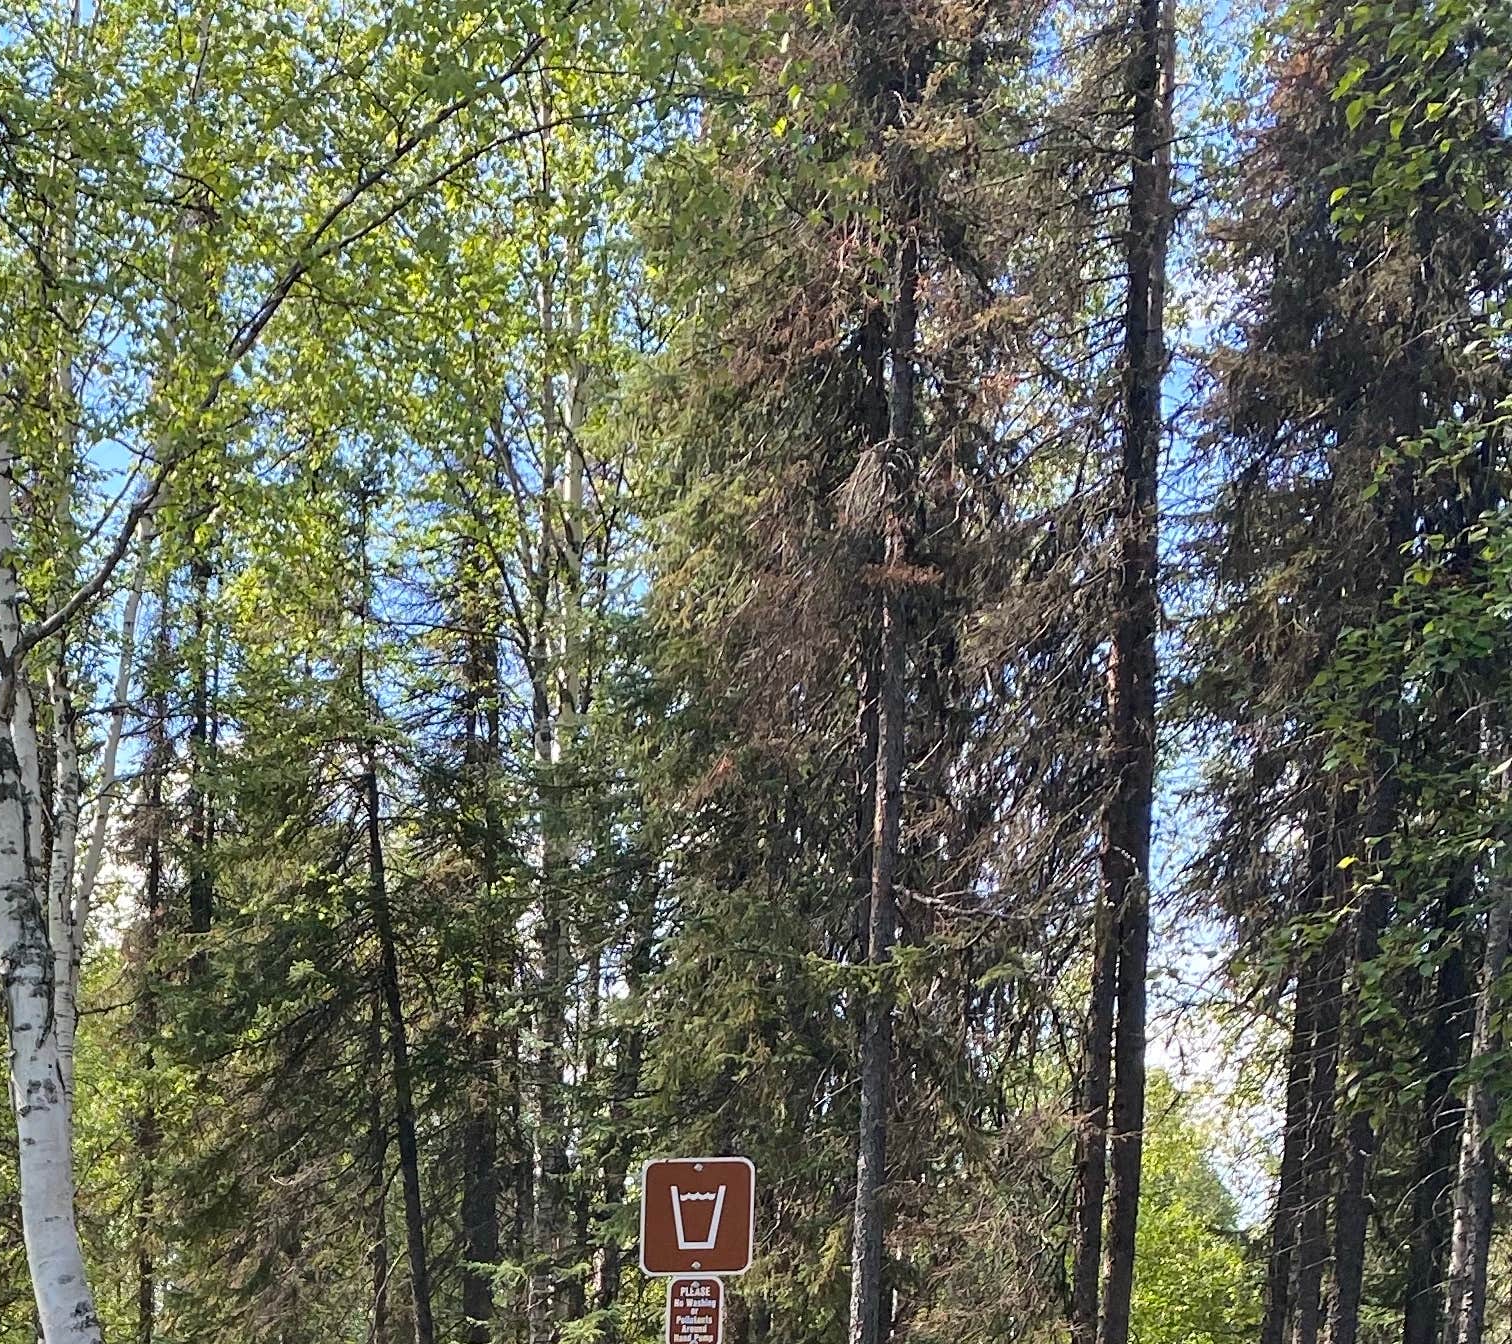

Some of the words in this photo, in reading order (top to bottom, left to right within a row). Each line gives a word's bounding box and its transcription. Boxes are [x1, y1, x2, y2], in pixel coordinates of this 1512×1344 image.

[680, 1286, 711, 1297] PLEASE
[673, 1298, 685, 1308] No
[686, 1298, 717, 1309] Washing
[681, 1324, 708, 1334] Around
[673, 1333, 693, 1343] Hand
